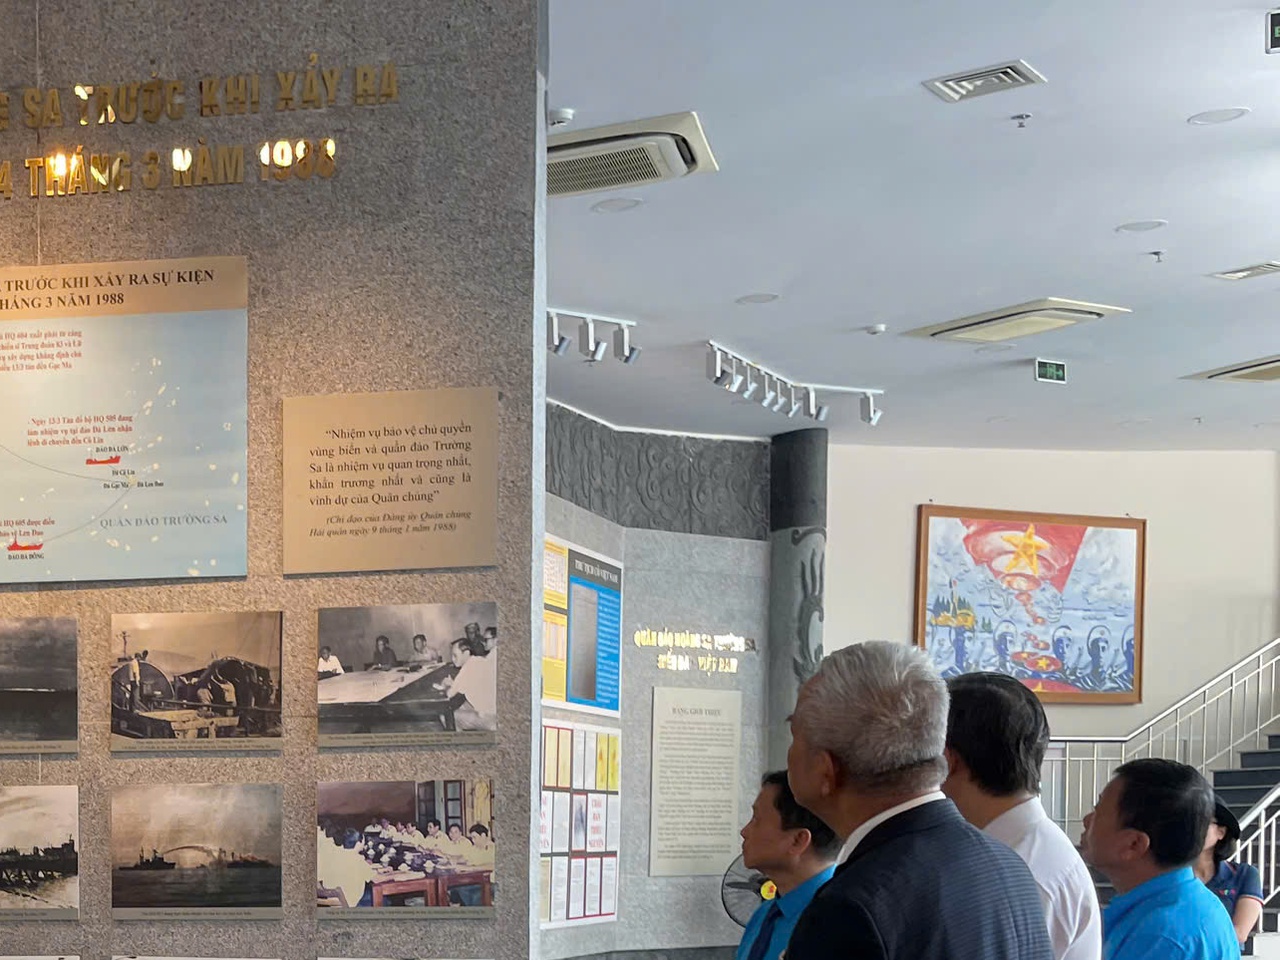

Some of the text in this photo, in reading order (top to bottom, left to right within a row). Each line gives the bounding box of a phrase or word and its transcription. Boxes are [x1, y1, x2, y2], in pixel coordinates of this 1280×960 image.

[23, 88, 63, 129] SA
[199, 74, 261, 118] KHI
[276, 53, 340, 112] XẢY
[354, 62, 401, 106] RA
[25, 144, 131, 197] THÁNG
[141, 150, 160, 190] 3
[172, 138, 245, 188] NĂM
[259, 138, 337, 182] 1988
[4, 275, 59, 292] TRƯỚC
[62, 276, 90, 289] KHI
[93, 271, 125, 288] XẢY
[129, 274, 150, 287] RA
[153, 270, 175, 288] SỰ
[177, 269, 216, 285] KIỆN
[45, 296, 53, 309] 3
[57, 293, 91, 308] NĂM
[96, 292, 125, 306] 1988
[326, 419, 471, 440] “Nhiệm vụ bảo vệ chủ quyền
[310, 440, 471, 458] vùng biển và quần đảo Trường
[309, 453, 471, 473] Sa là nhiệm vụ quan trọng nhất,
[310, 470, 471, 490] khẩn trương nhất và cũng là
